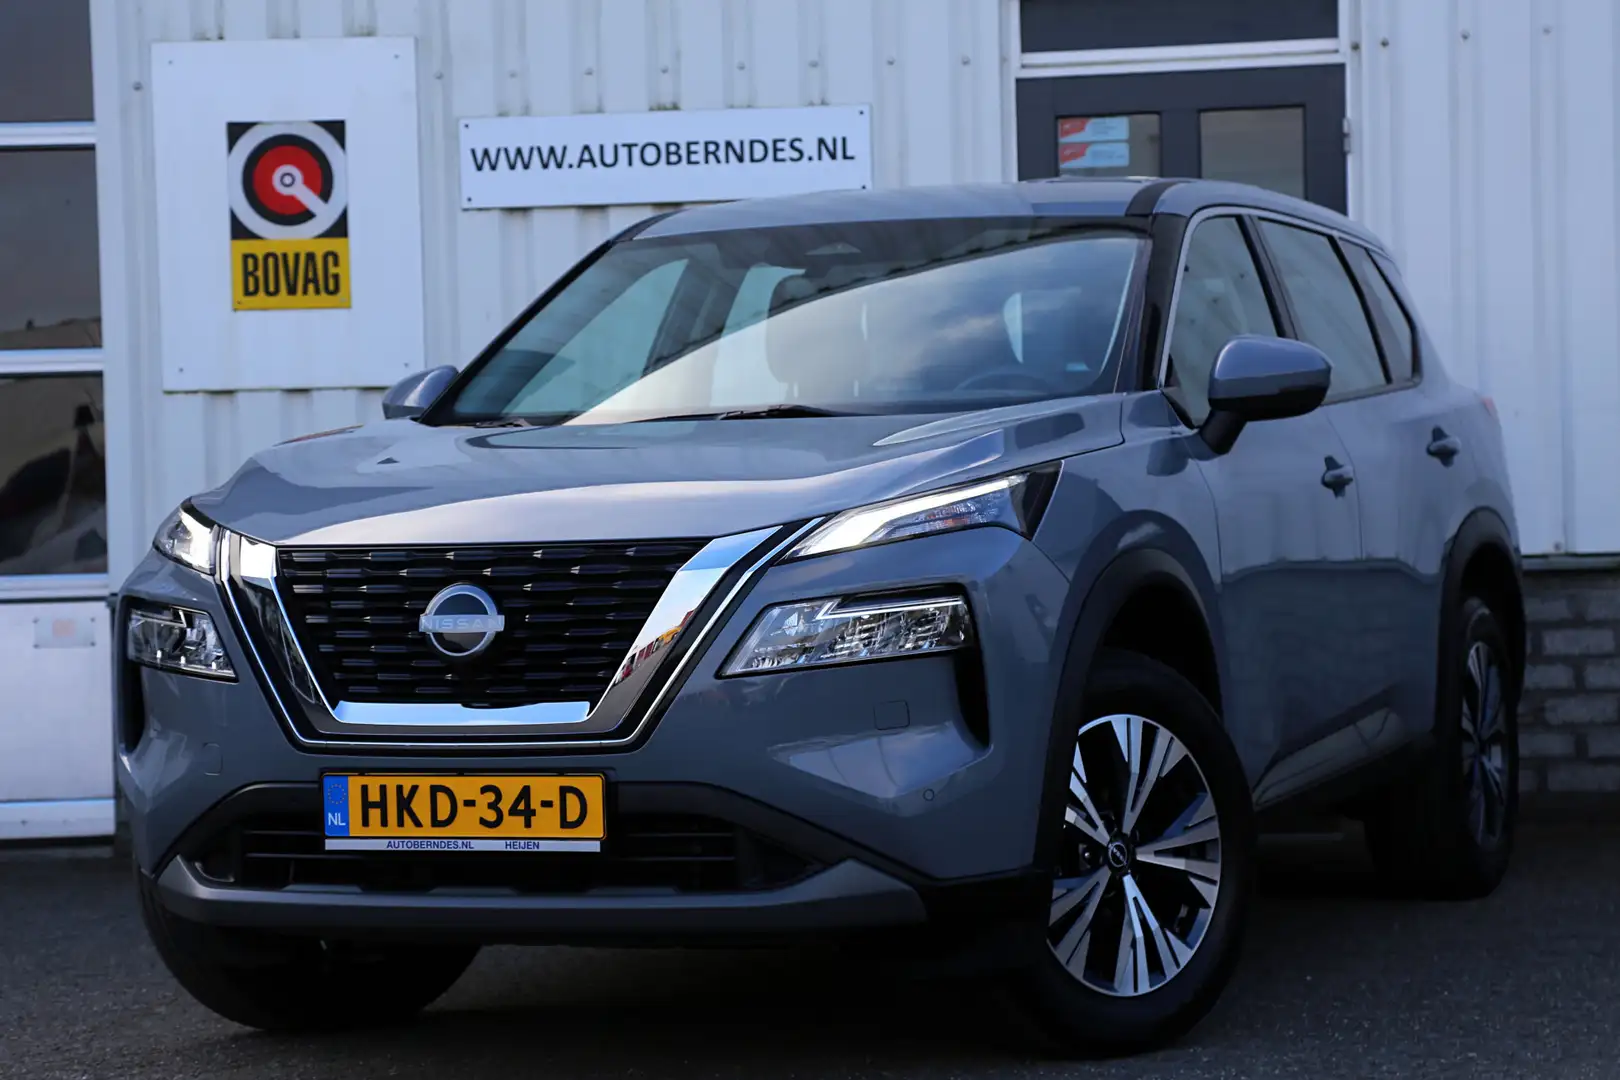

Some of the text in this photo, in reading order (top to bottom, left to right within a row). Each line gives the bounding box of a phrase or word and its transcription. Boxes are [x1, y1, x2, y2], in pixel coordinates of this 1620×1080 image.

[470, 136, 856, 172] WWW.AUTOBERNDES.NL
[241, 250, 341, 297] BOVAG
[421, 618, 502, 630] NISSAN
[360, 783, 588, 829] HKD-34-D
[328, 813, 346, 826] NL
[386, 840, 540, 850] AUTOBERNDES.NL HEIJEN
